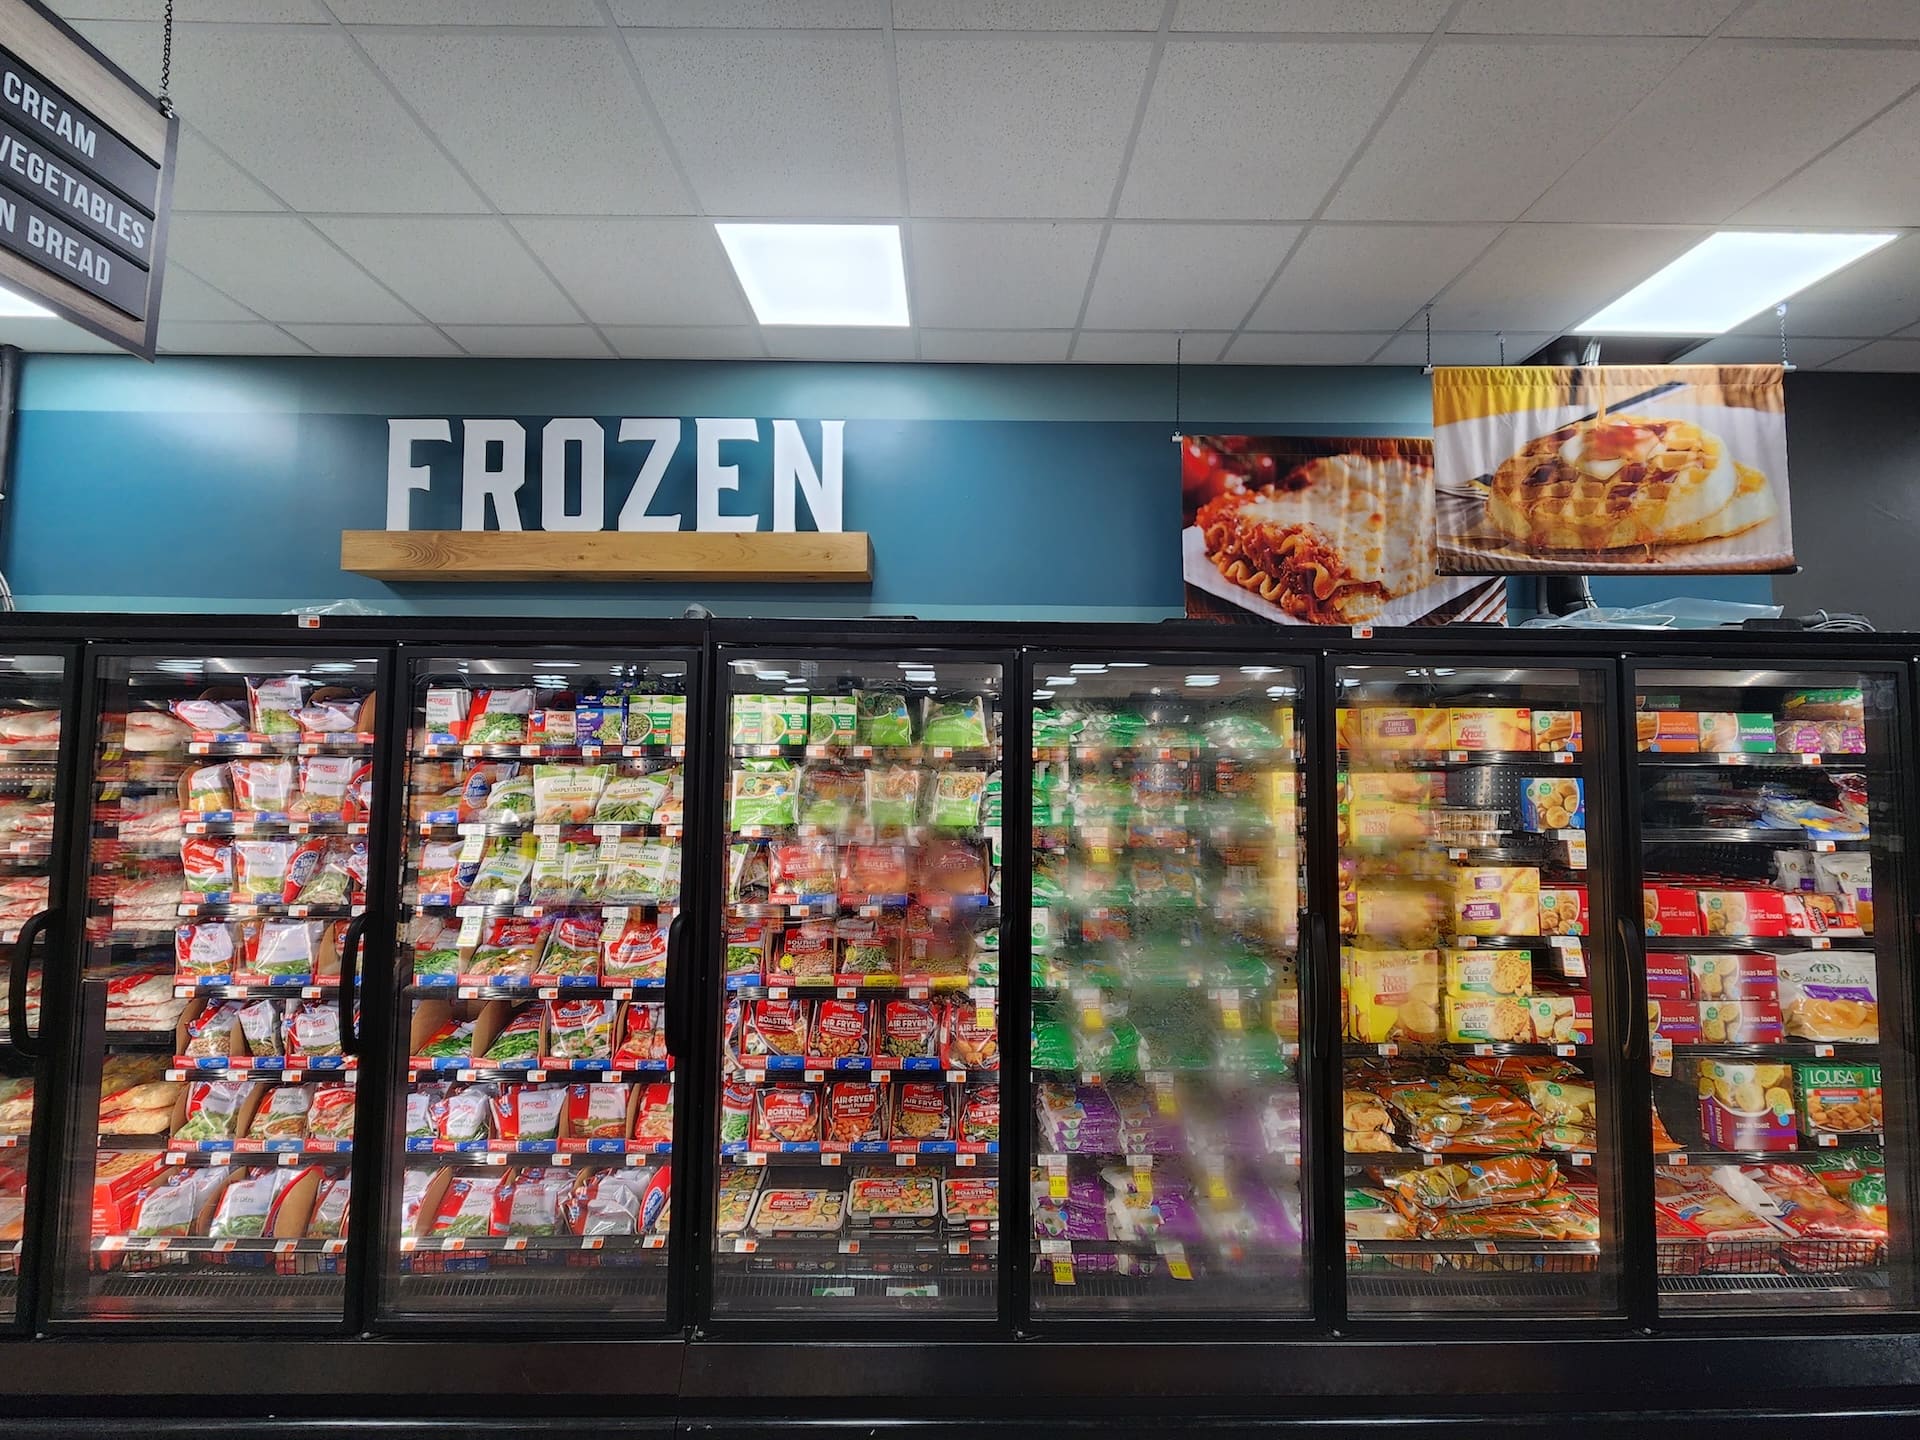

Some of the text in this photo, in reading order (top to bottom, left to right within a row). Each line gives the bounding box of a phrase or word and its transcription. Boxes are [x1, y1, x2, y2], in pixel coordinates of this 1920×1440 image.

[3, 71, 97, 159] CREAM
[27, 215, 111, 286] BREAD
[386, 417, 846, 533] FROZEN
[758, 1015, 793, 1026] ROASTING
[821, 1019, 862, 1029] AIR FRYER
[888, 1020, 902, 1028] AIR
[1810, 1069, 1856, 1084] LOUISA
[834, 1094, 875, 1104] AIR FRYER
[920, 1099, 943, 1107] FRYER
[767, 1108, 806, 1117] ROASTING
